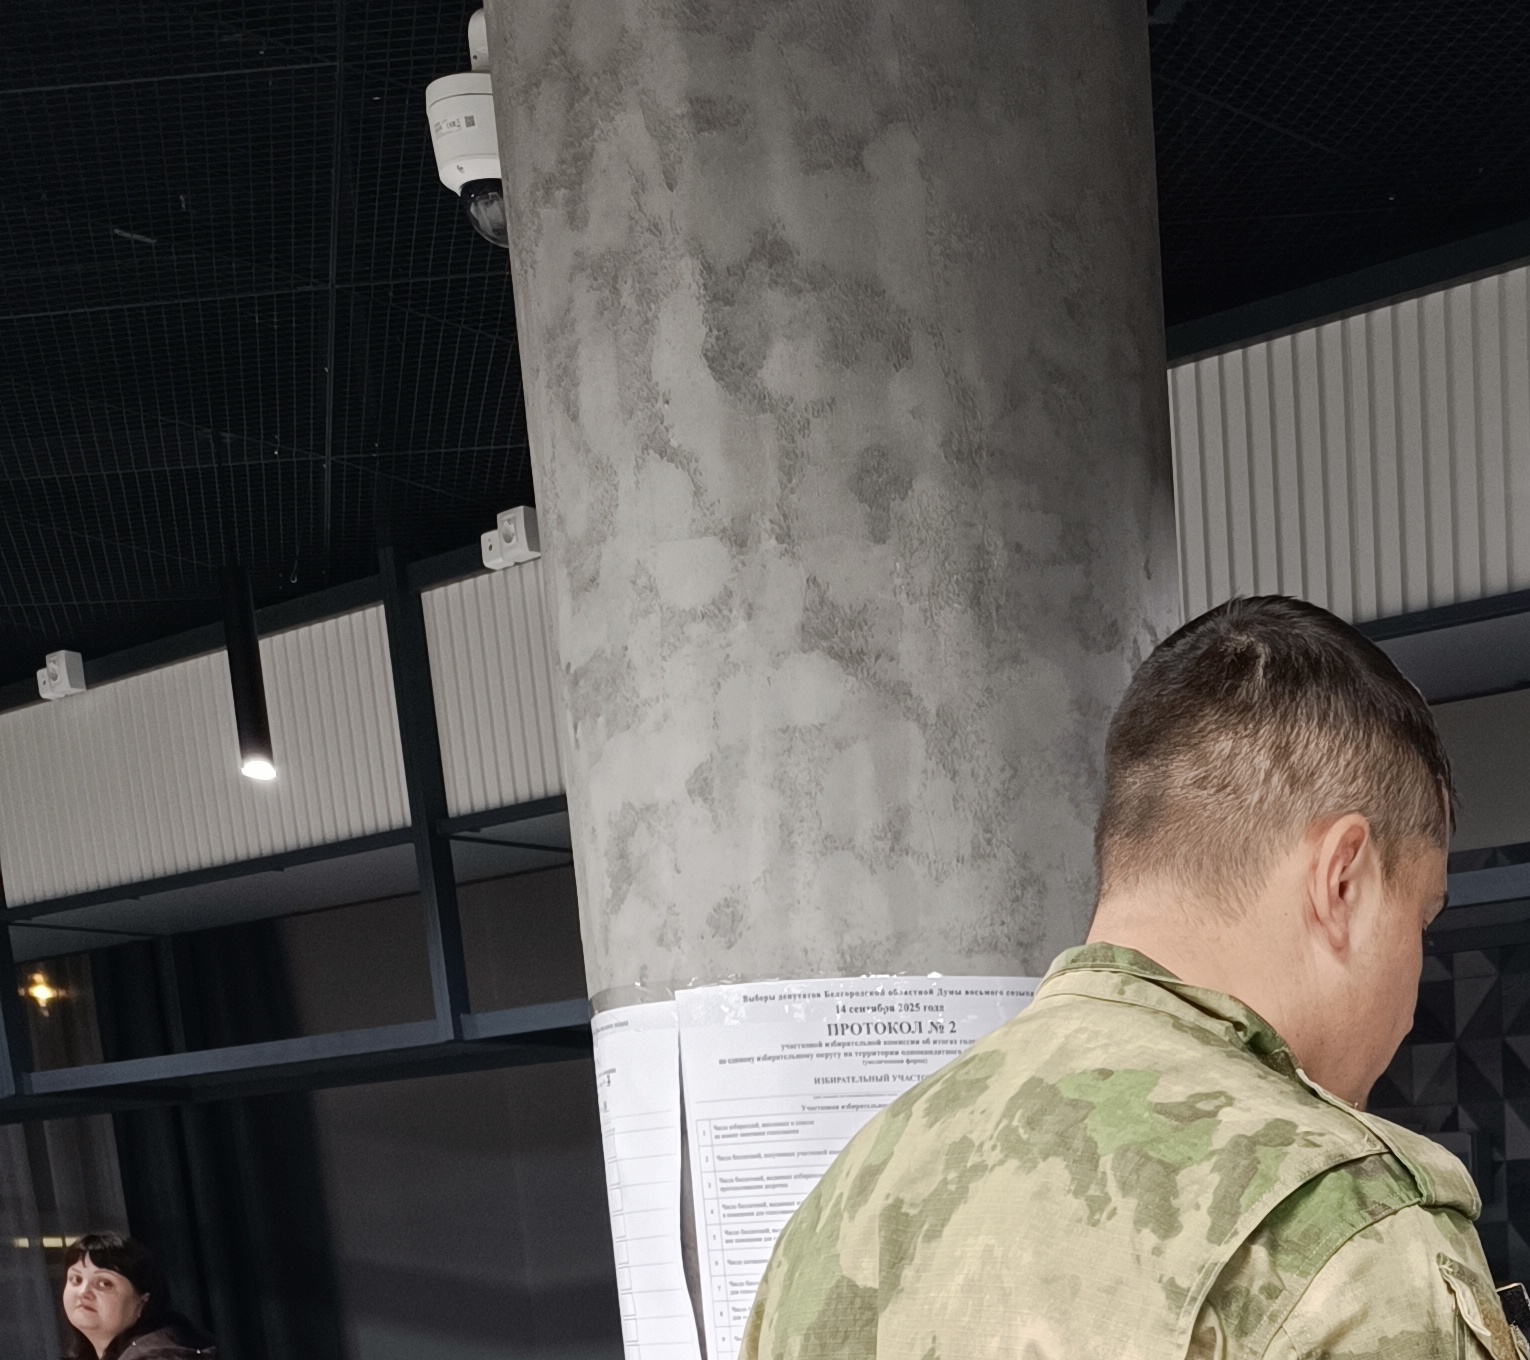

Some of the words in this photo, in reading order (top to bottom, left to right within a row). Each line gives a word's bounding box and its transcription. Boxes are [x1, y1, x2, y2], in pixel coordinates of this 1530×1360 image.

[824, 989, 885, 999] Белгородской
[937, 988, 962, 998] Думы
[835, 1004, 846, 1014] 14
[849, 1003, 895, 1015] сентября
[899, 1003, 920, 1012] 2025
[923, 1004, 945, 1012] года
[827, 1021, 923, 1036] ПРОТОКОЛ
[928, 1021, 945, 1034] №
[949, 1020, 957, 1034] 2
[814, 1073, 890, 1085] ИЗБИРАТЕЛЬНЫЙ
